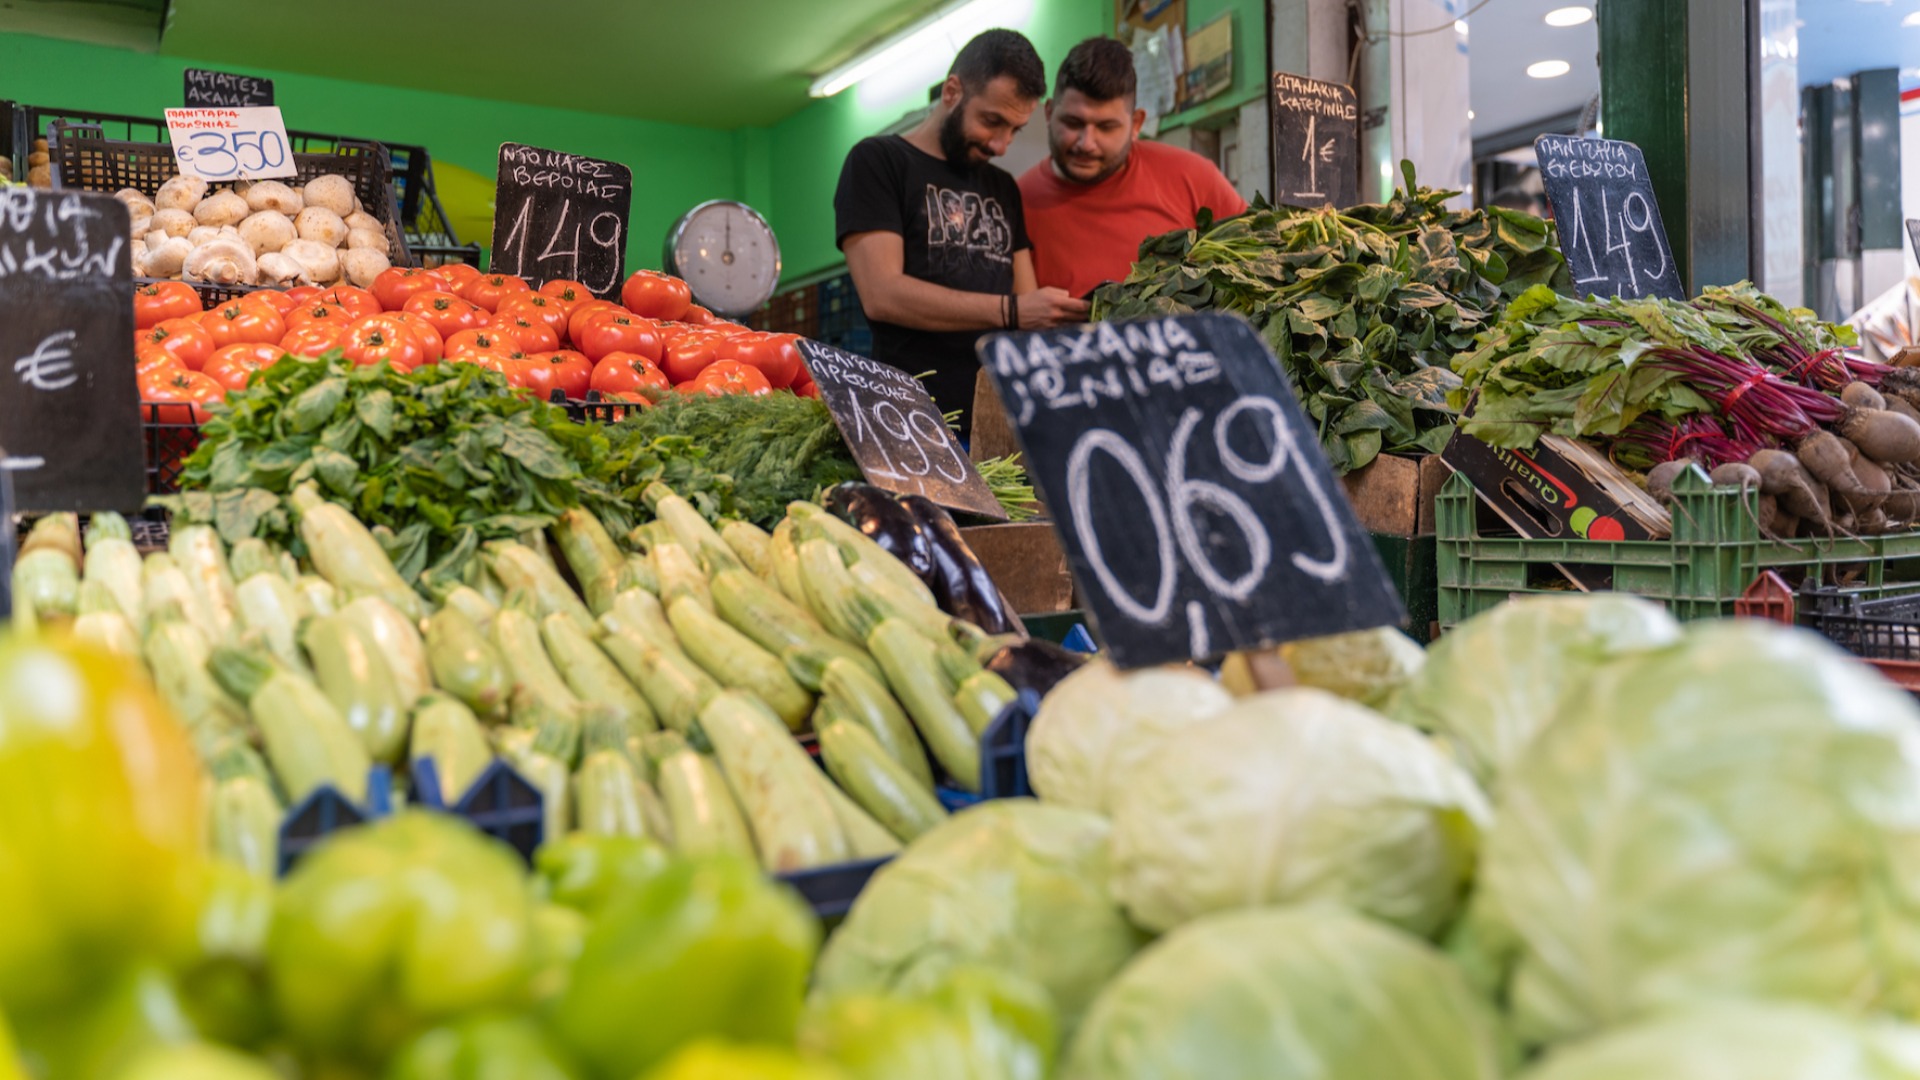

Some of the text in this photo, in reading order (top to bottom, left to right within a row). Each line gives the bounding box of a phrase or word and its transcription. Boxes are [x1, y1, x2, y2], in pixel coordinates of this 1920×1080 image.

[1276, 74, 1343, 102] ΣΠΑΝΑΚΙΑ
[1278, 91, 1357, 120] ΚΑΤΕΡΙΝΗΣ
[512, 165, 624, 200] ΒΕΡΟΙΑΣ
[995, 316, 1198, 377] ΛΑΧΑΝΑ
